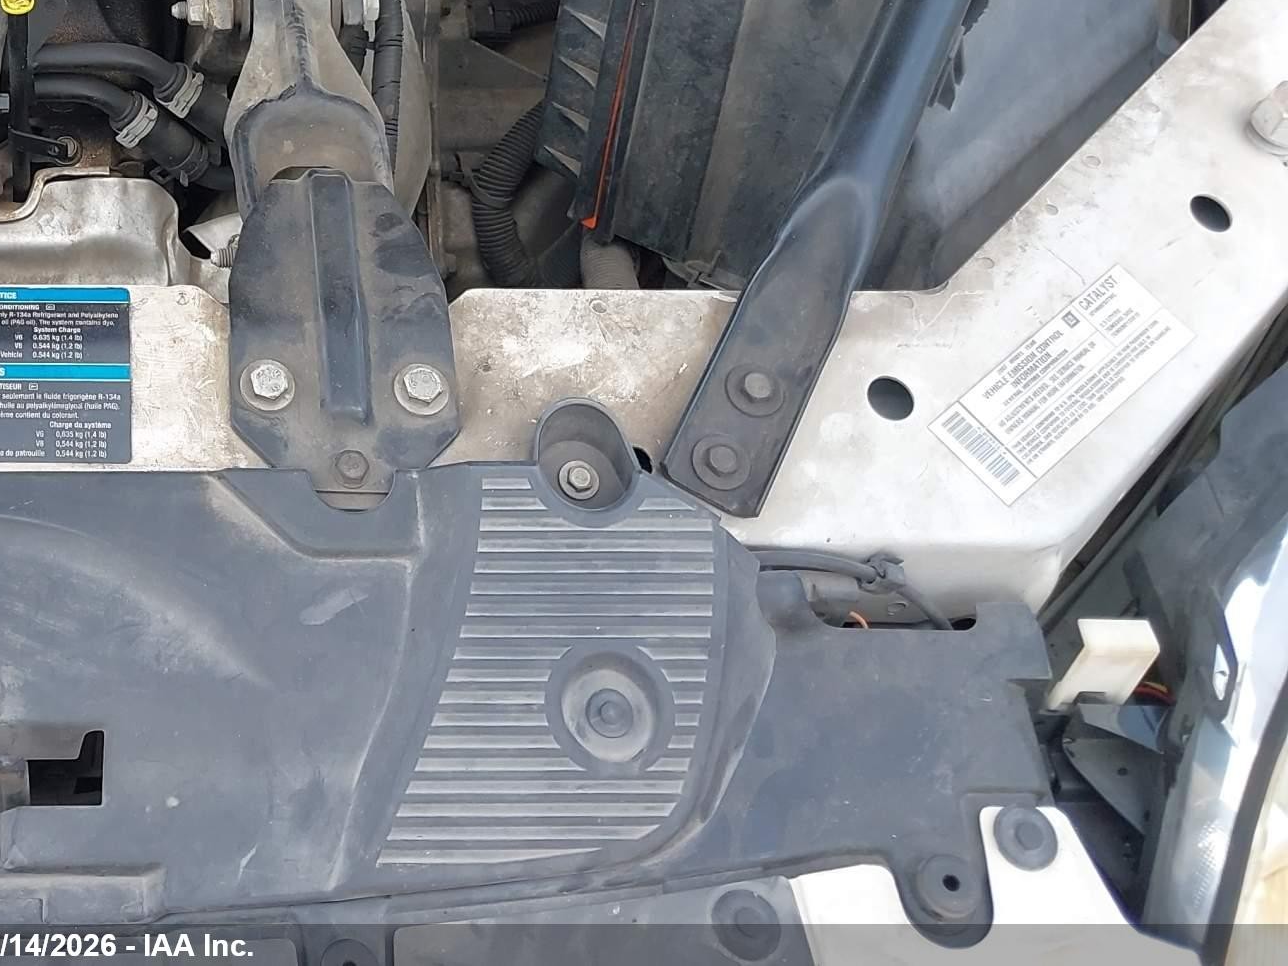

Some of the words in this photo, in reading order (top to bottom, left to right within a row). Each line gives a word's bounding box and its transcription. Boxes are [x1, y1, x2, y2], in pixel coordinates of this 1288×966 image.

[1077, 274, 1118, 311] CATALYST
[981, 375, 1009, 400] VEHICLE
[1007, 350, 1037, 378] EMISSION
[1034, 327, 1064, 354] CONTROL
[1010, 351, 1052, 388] INFORMATION
[50, 421, 72, 429] Charge
